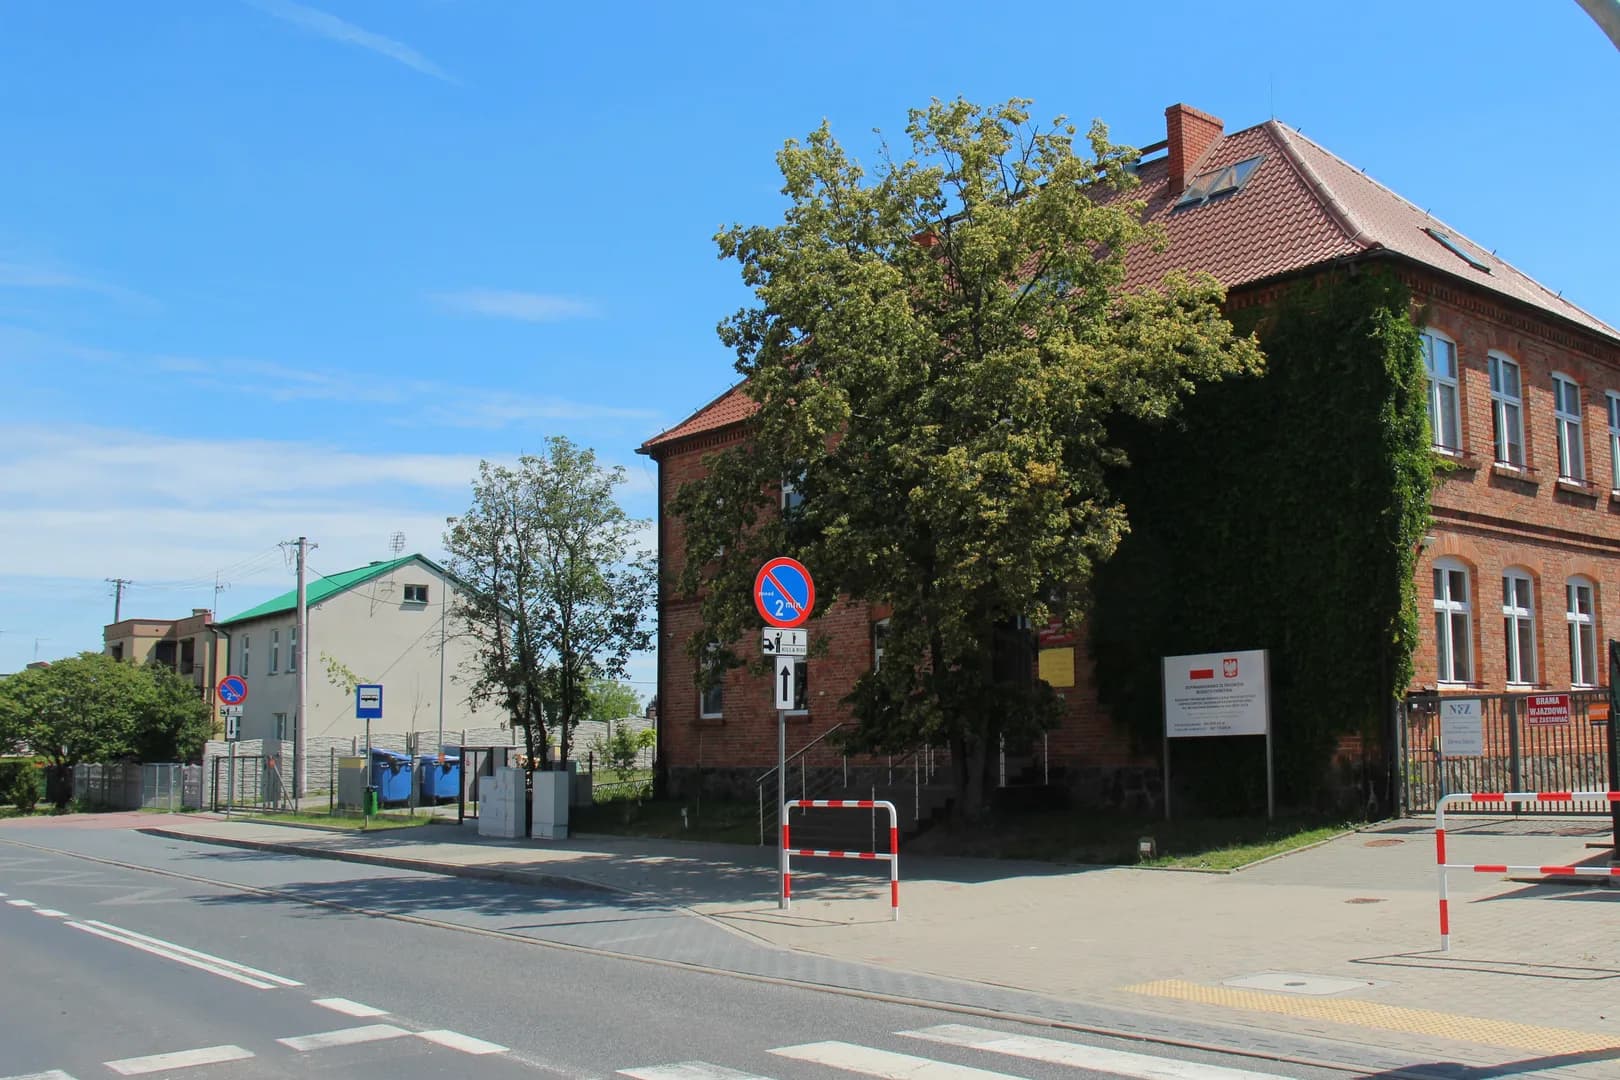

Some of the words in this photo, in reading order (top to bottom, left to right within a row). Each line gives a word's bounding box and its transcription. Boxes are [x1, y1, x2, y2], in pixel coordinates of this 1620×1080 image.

[775, 599, 784, 616] 2
[227, 692, 232, 700] 2
[1536, 697, 1559, 705] BRAMA
[1530, 707, 1567, 716] WJAZDOWA
